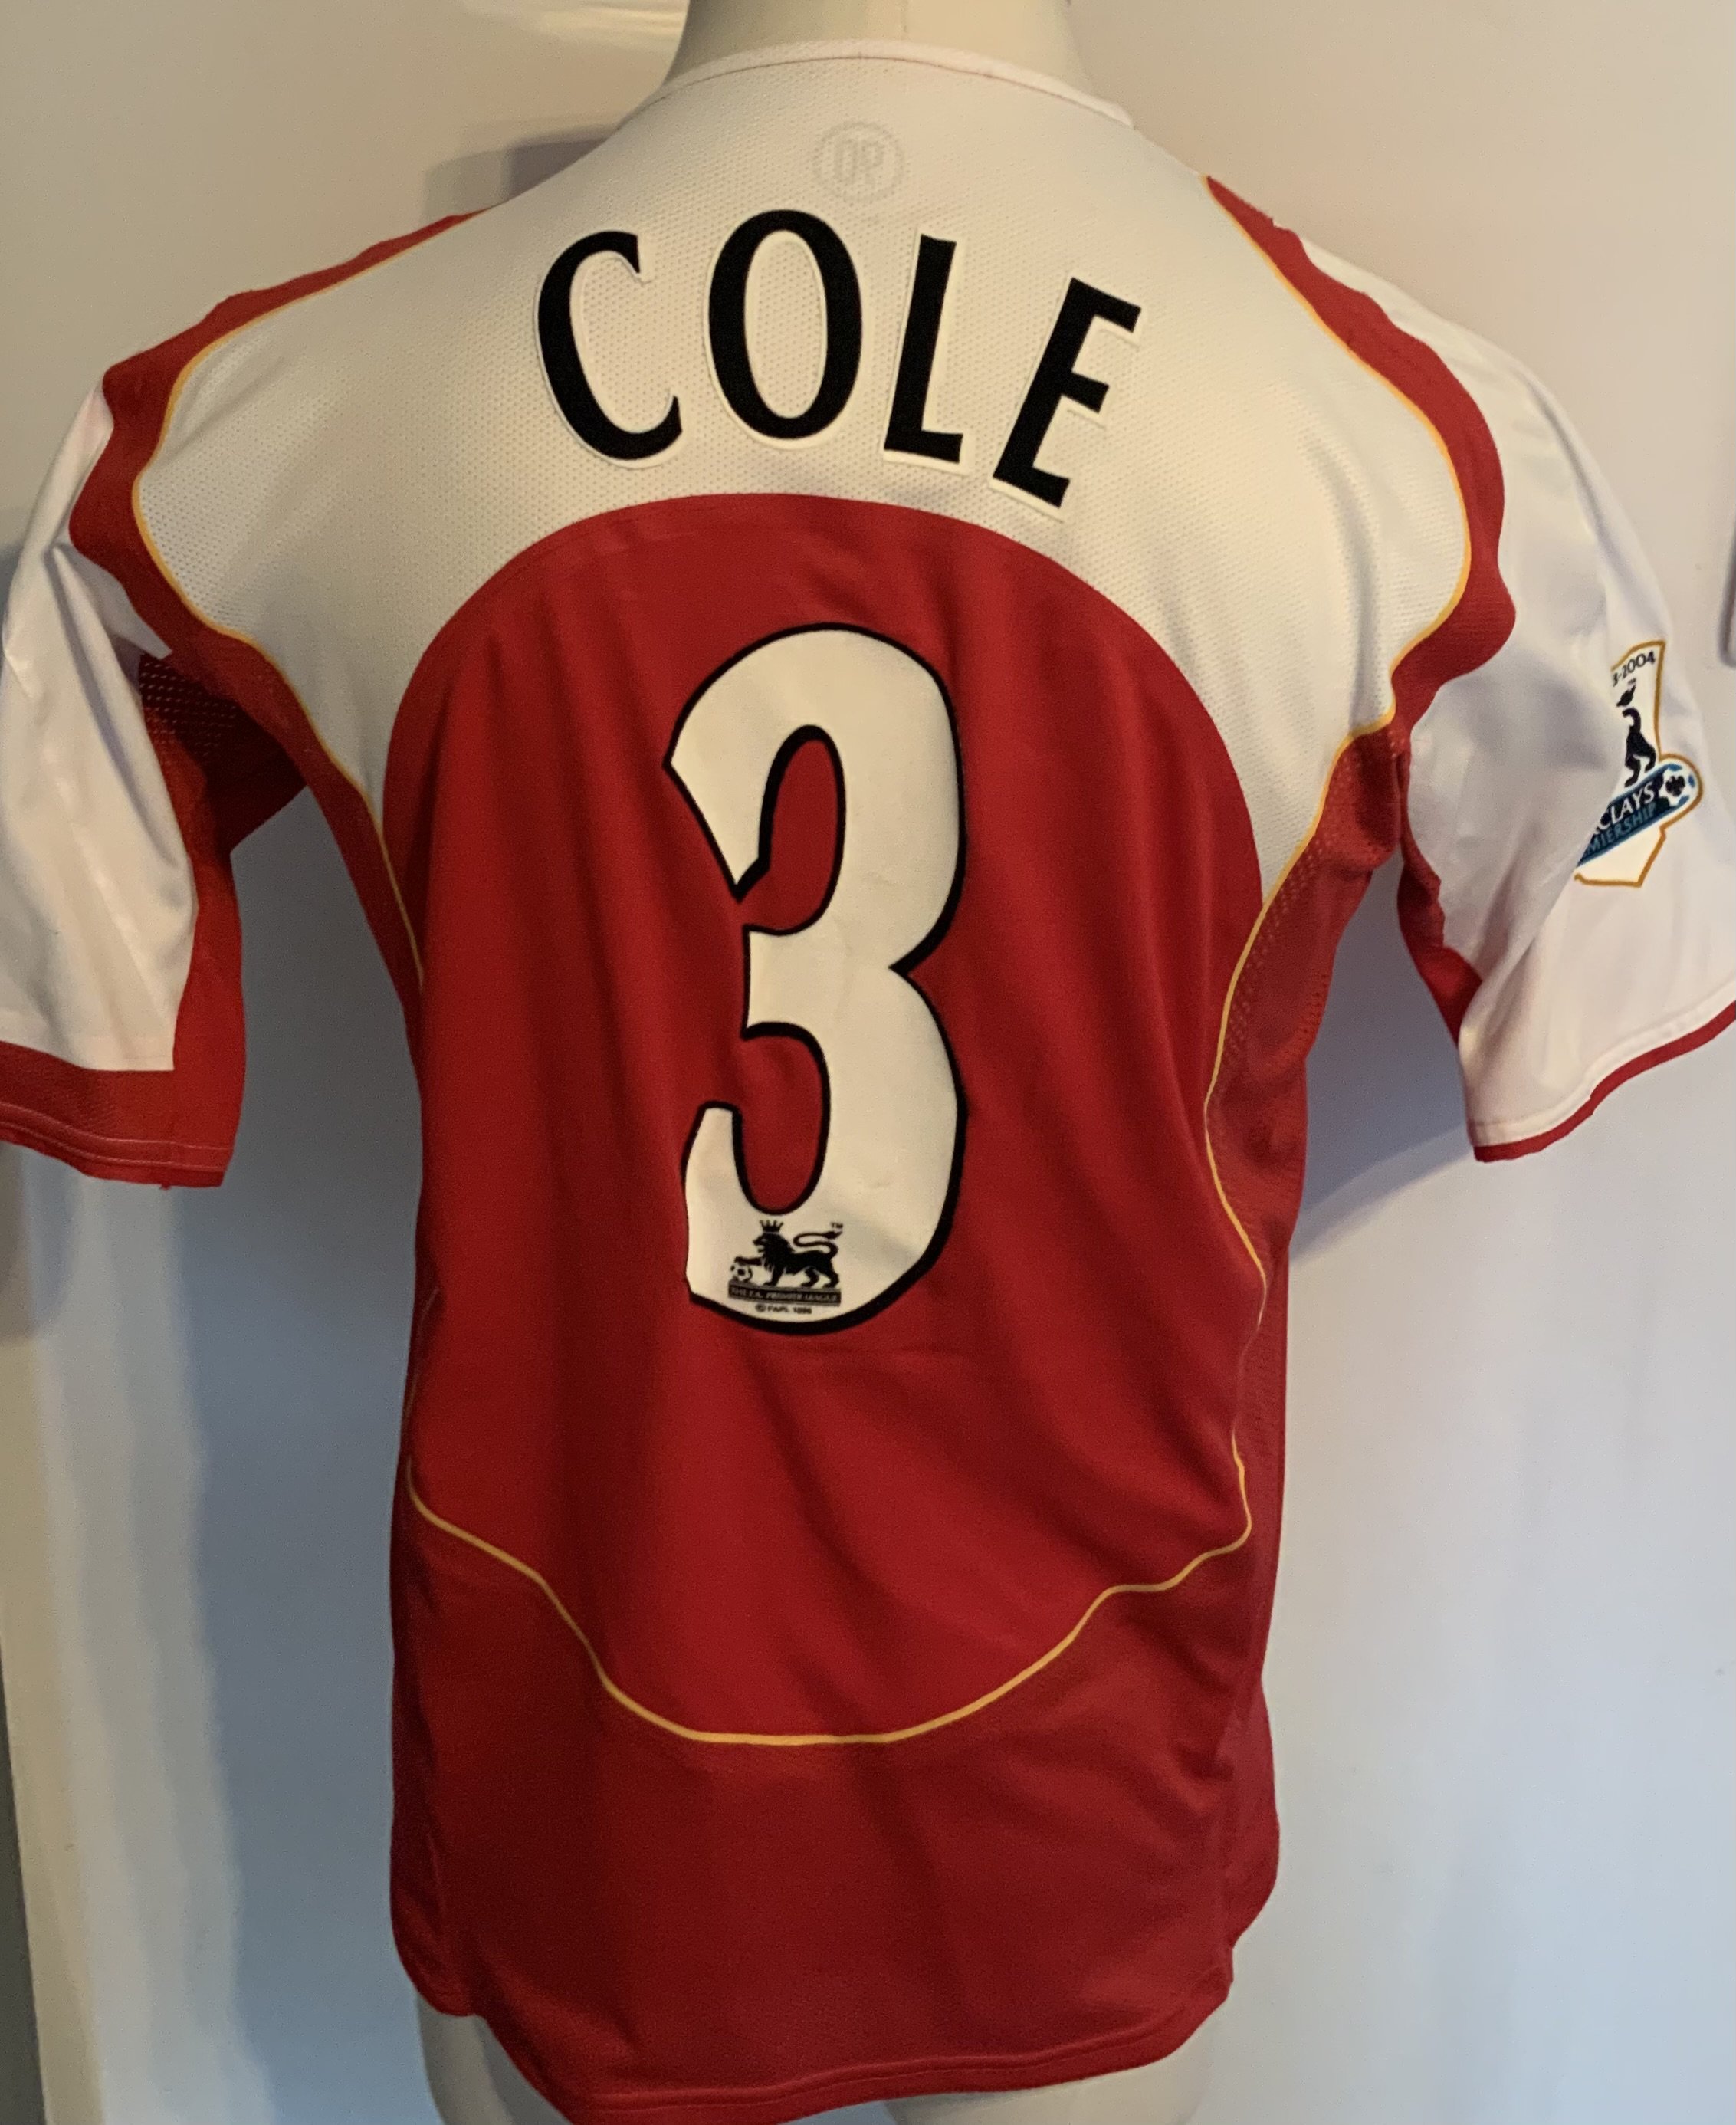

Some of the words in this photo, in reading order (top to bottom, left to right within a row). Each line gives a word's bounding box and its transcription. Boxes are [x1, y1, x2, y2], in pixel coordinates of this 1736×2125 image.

[537, 209, 1142, 508] COLE
[1584, 803, 1656, 856] MIERSHIP
[1594, 781, 1655, 834] CLAYS
[665, 622, 966, 1334] 3
